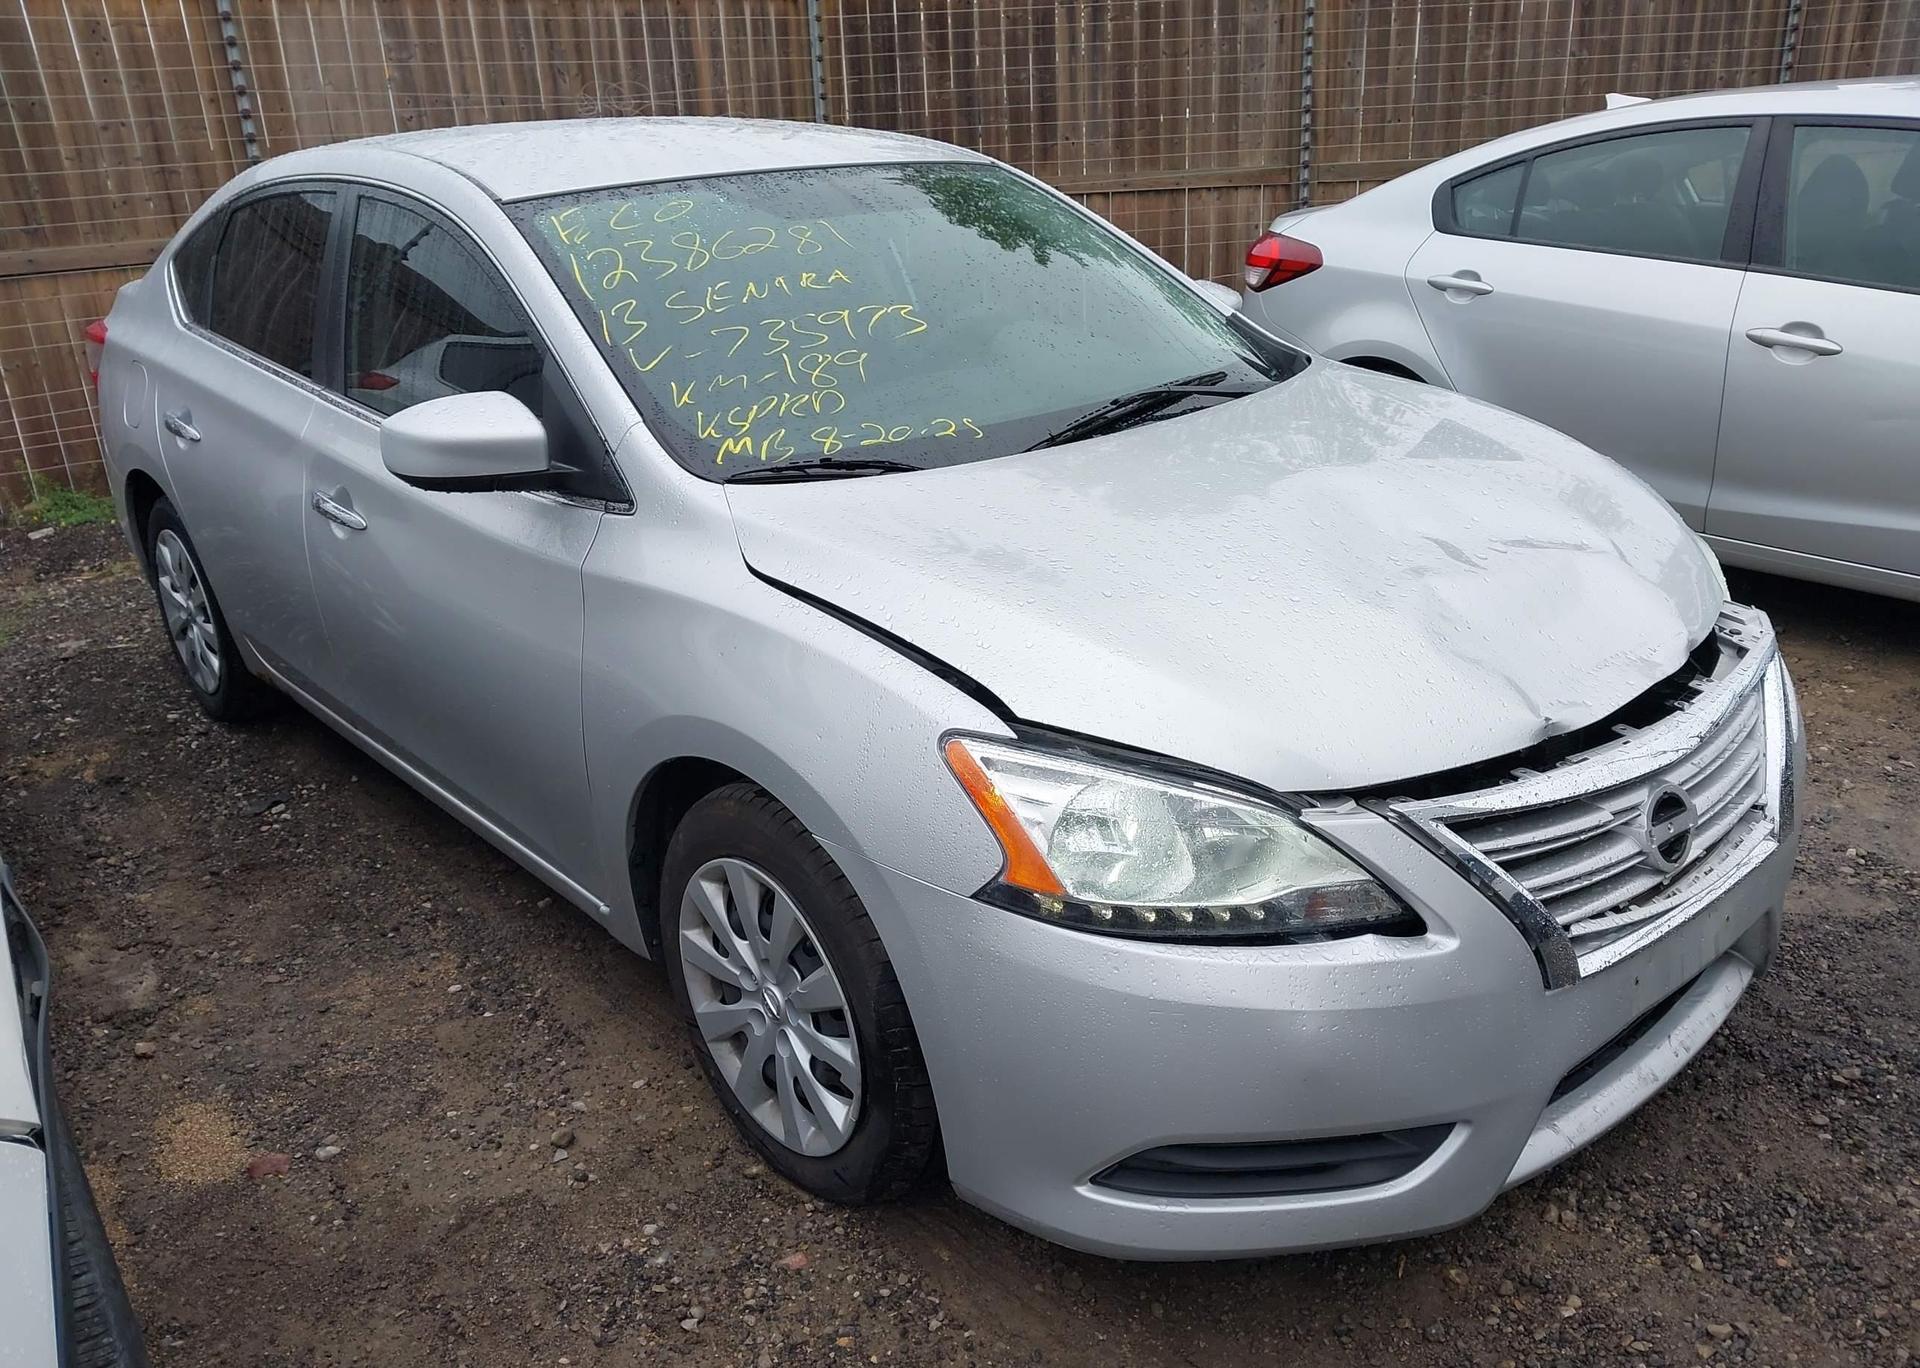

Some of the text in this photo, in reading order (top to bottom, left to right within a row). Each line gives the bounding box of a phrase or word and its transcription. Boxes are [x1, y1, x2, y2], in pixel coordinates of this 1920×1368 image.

[569, 220, 856, 301] 12386281
[600, 269, 852, 346] 13 SENTRA
